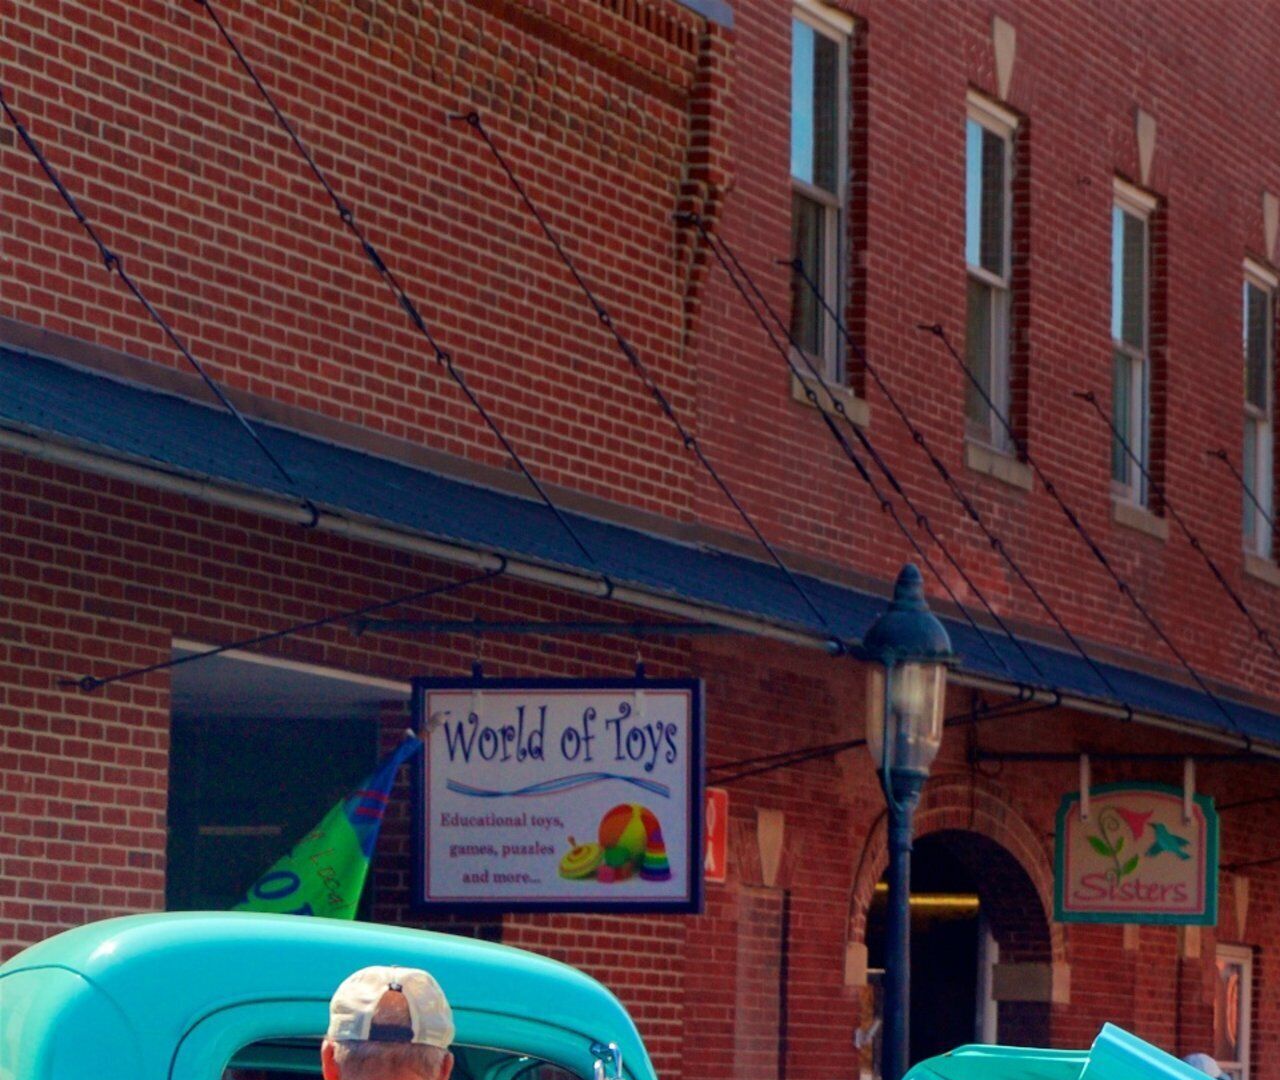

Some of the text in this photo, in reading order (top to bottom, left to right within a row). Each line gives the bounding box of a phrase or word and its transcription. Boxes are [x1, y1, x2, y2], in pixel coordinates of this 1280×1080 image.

[443, 702, 678, 772] World of Toys
[440, 813, 564, 830] Educational toys,
[449, 842, 555, 858] games, puzzles
[462, 871, 488, 885] and
[1073, 872, 1188, 903] Sisters
